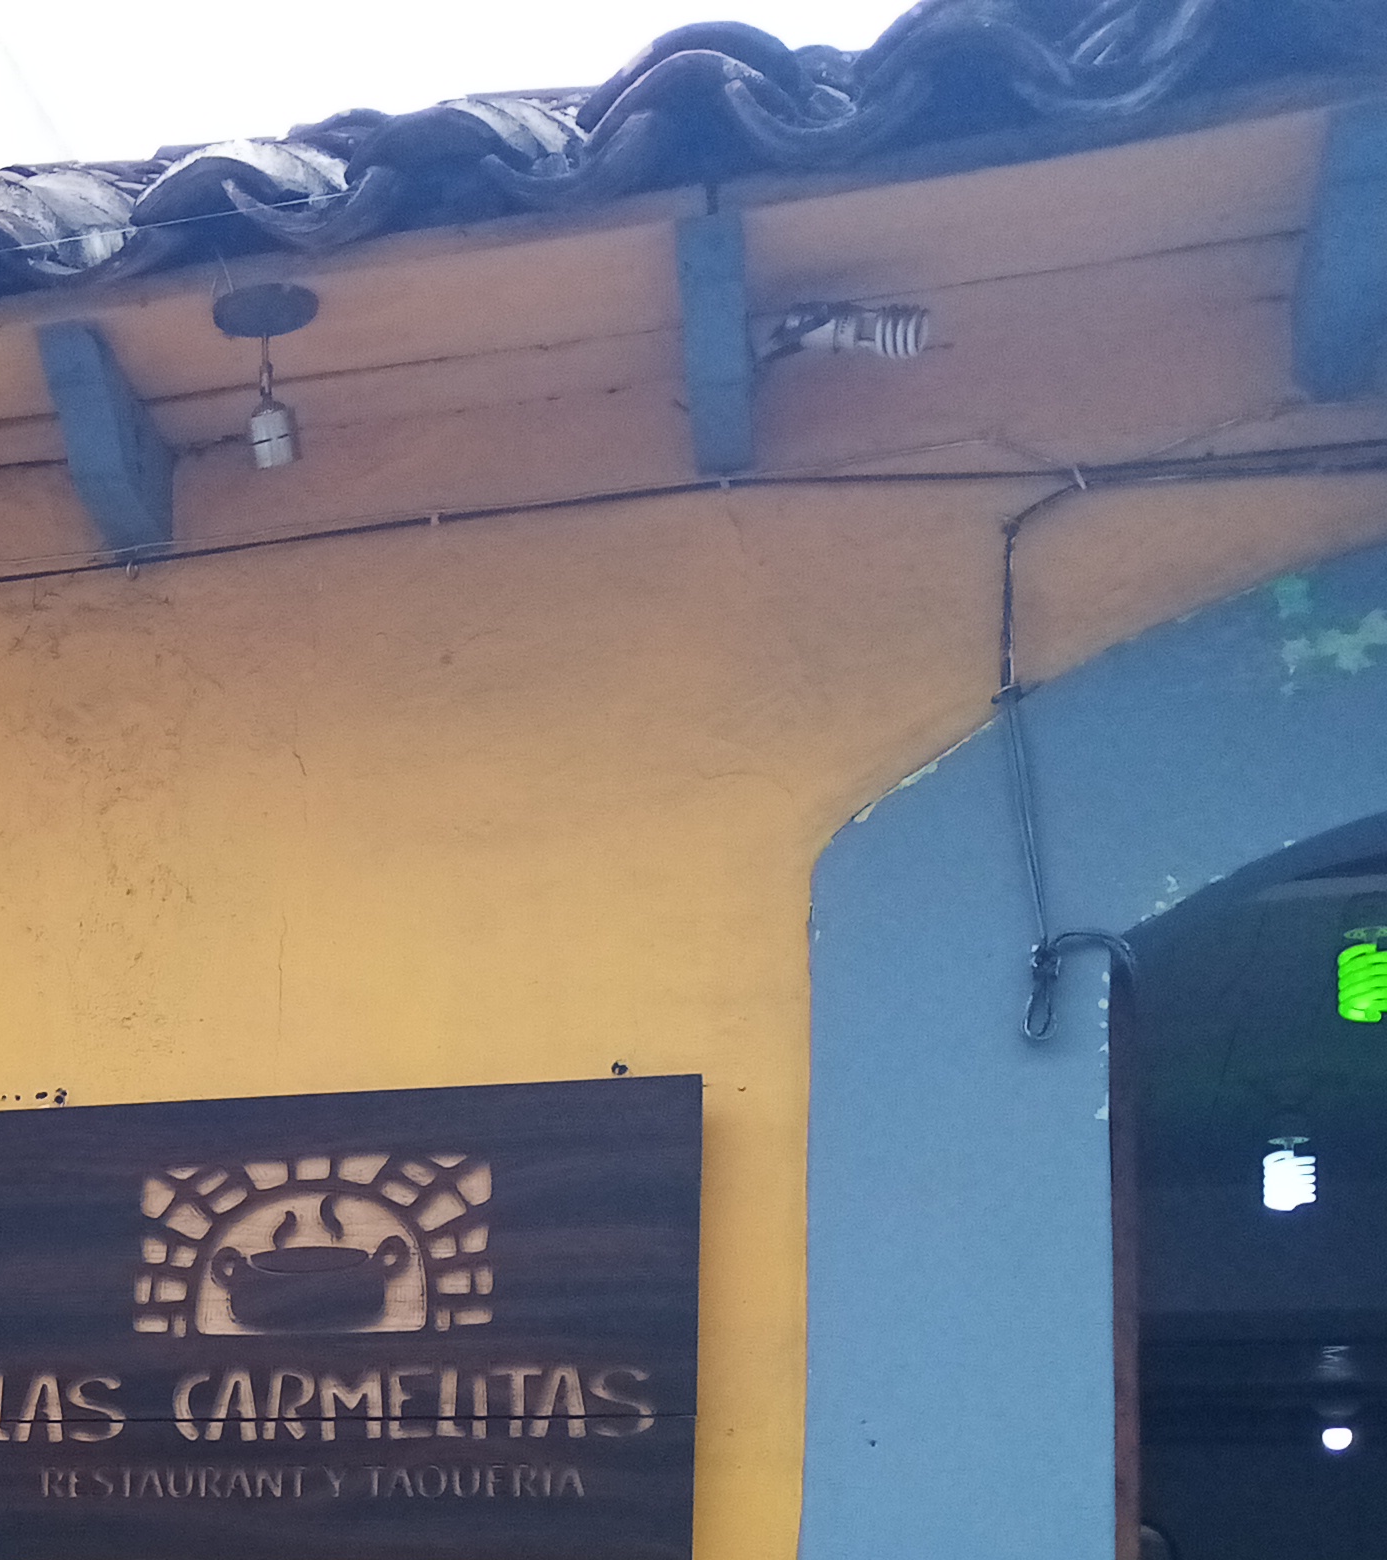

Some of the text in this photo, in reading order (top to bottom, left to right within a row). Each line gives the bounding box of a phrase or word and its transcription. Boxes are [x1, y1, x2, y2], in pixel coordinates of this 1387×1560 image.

[172, 1363, 657, 1443] CARMELITAS
[39, 1464, 308, 1500] RESTAURANT
[322, 1465, 348, 1499] Y
